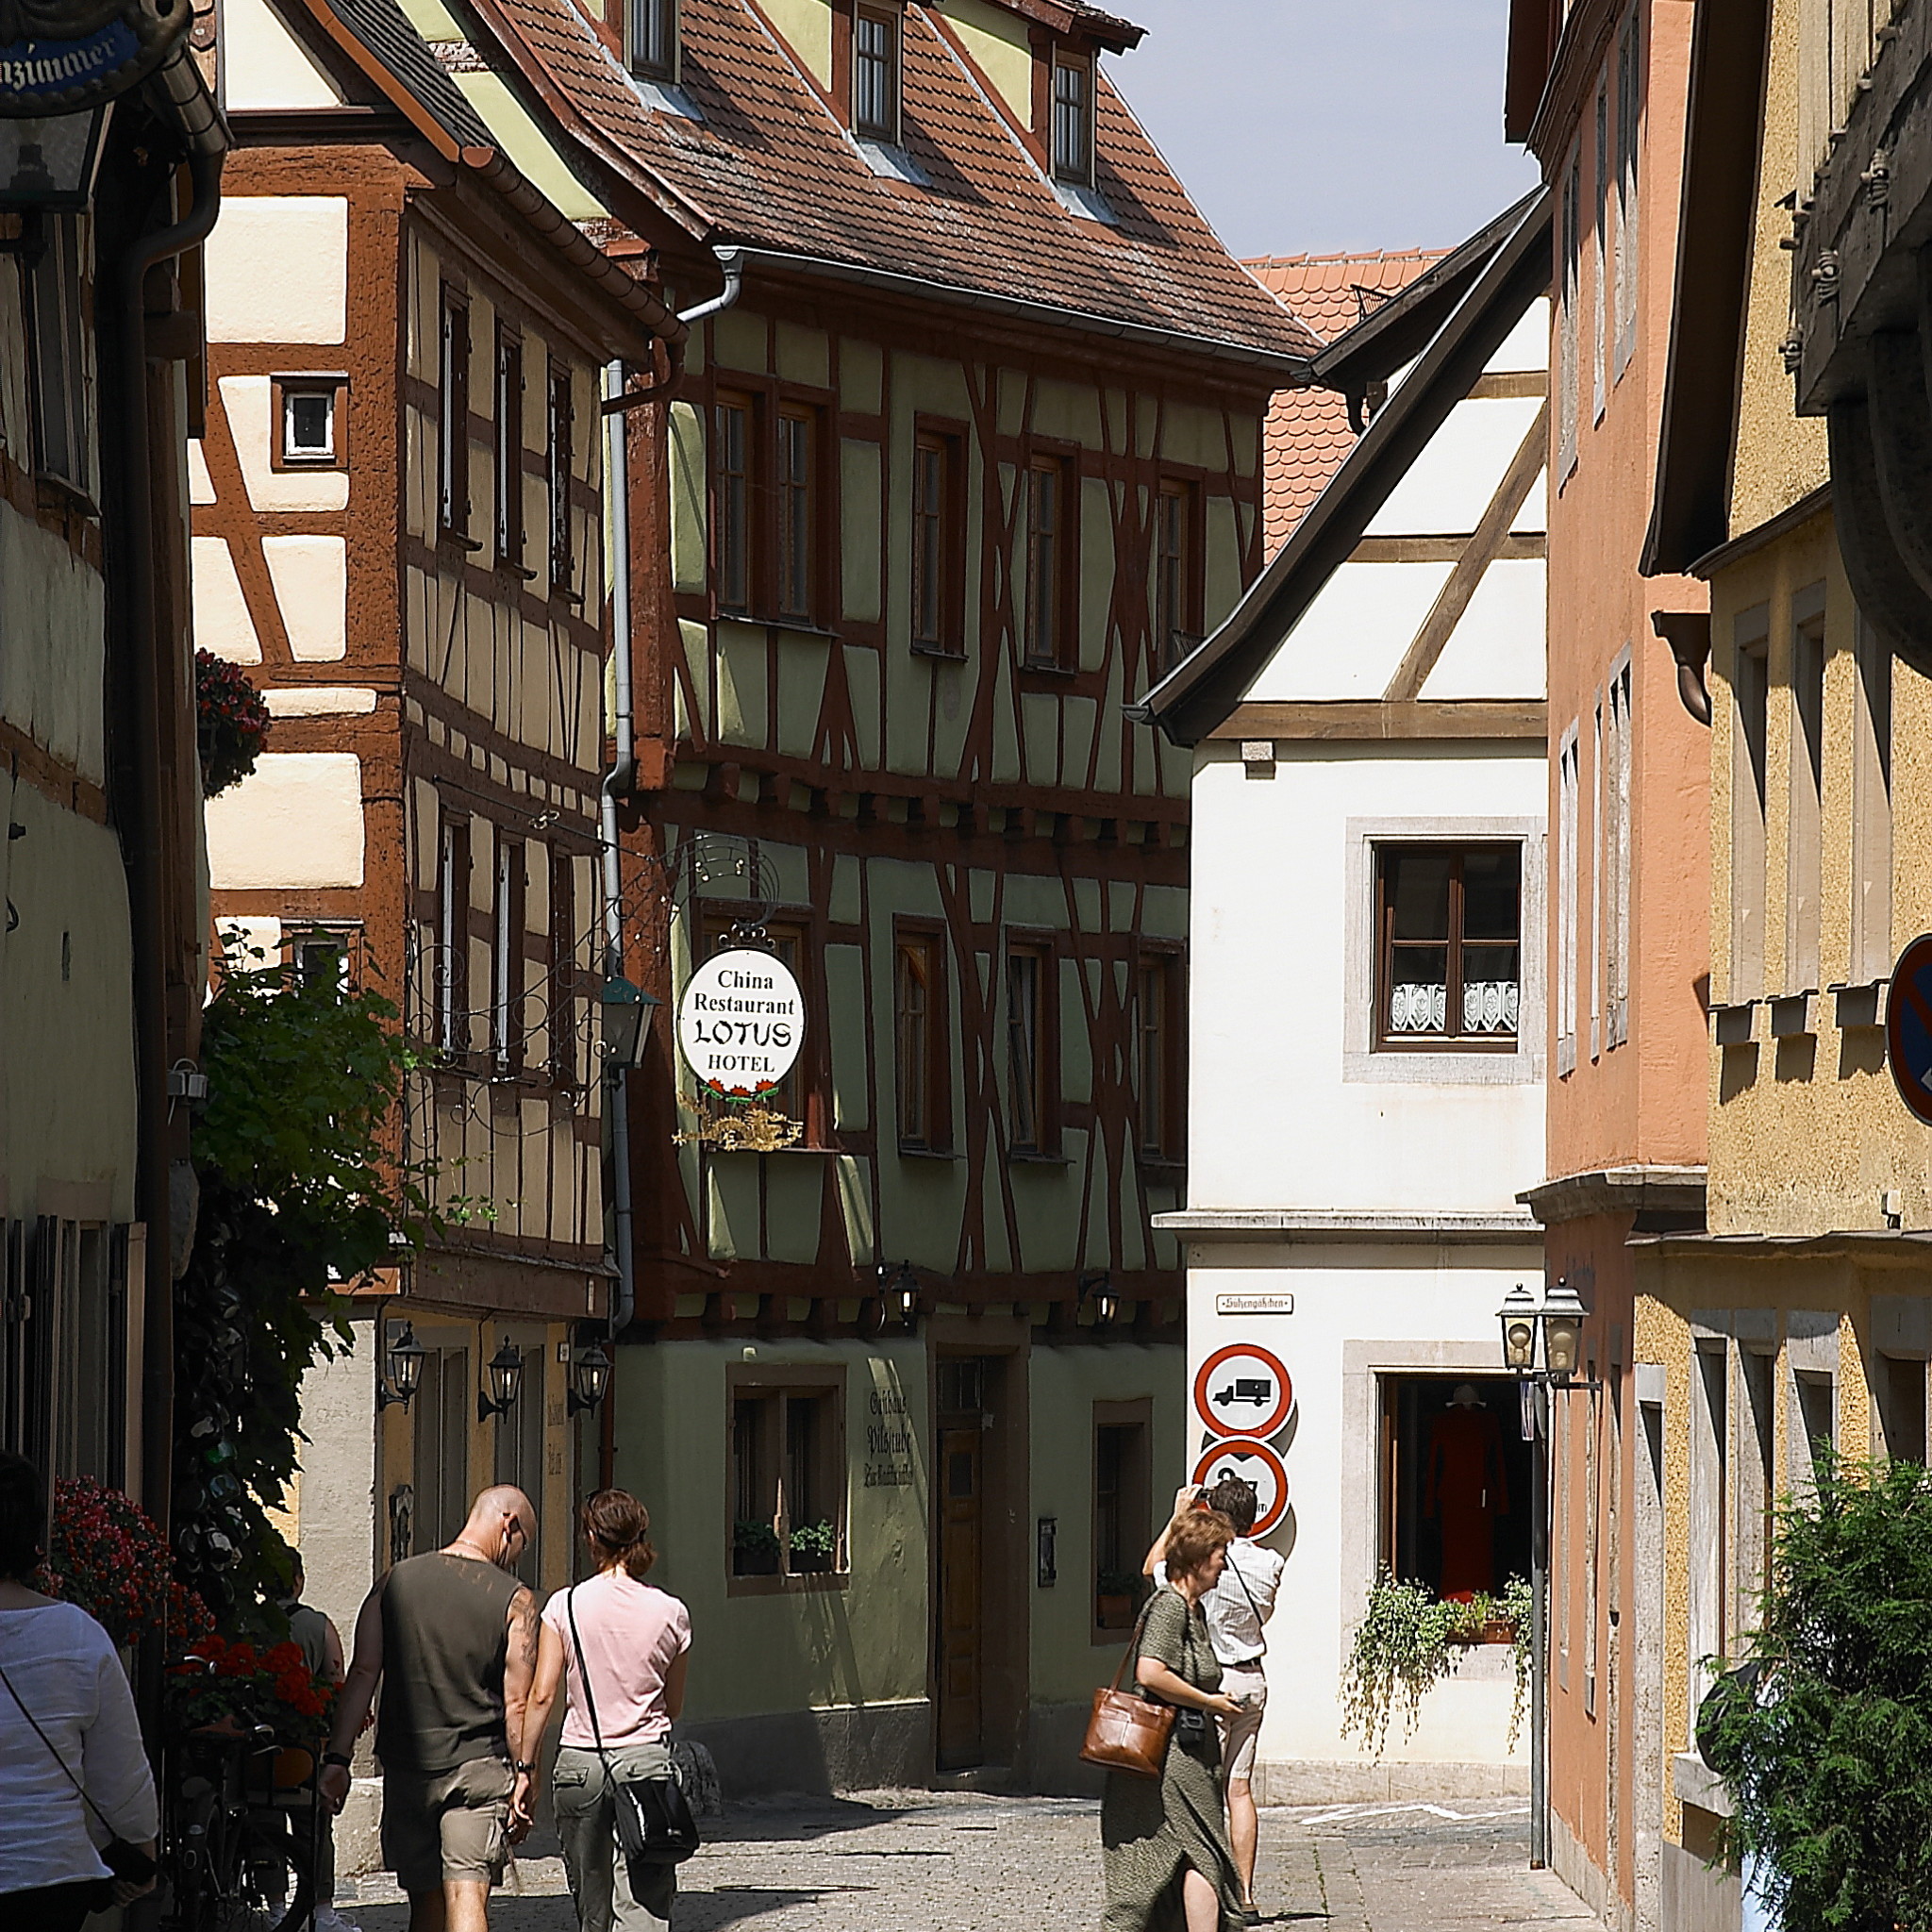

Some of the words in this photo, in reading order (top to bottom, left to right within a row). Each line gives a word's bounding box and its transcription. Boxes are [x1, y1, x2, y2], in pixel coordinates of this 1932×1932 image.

[718, 970, 774, 990] China
[694, 992, 795, 1015] Restaurant
[693, 1019, 791, 1047] LOTUS
[708, 1054, 775, 1073] HOTEL
